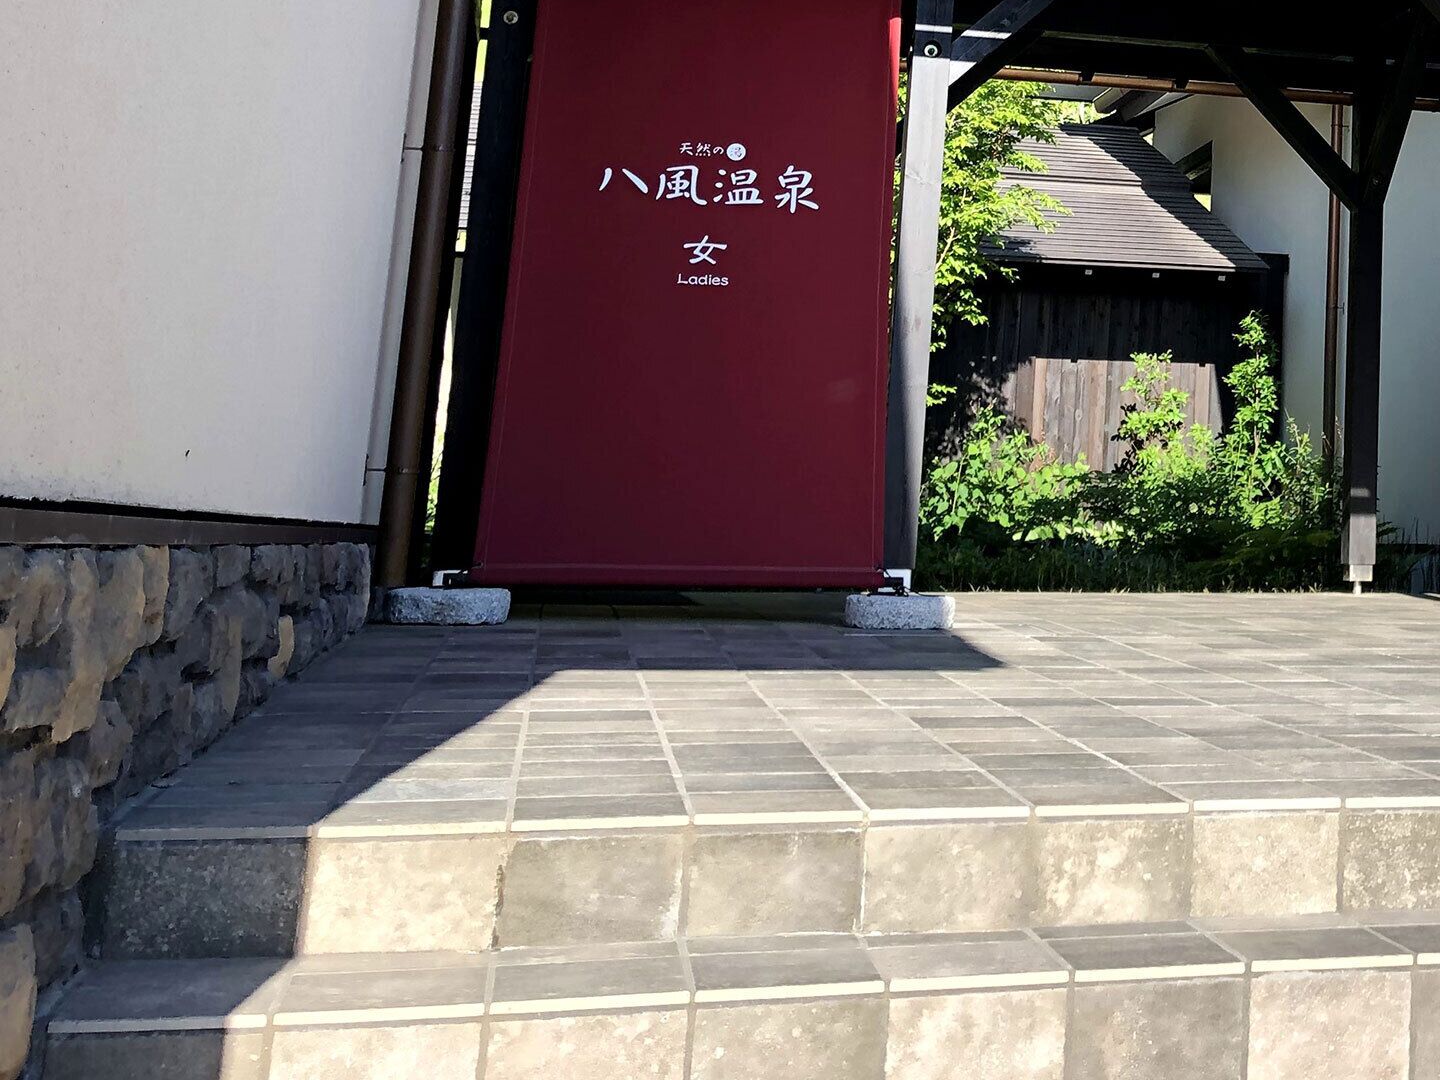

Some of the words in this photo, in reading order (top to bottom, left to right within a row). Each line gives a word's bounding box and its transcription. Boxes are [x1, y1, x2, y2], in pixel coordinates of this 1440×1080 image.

[598, 164, 820, 214] 八風温泉
[683, 234, 728, 265] 女
[676, 273, 729, 286] Ladies
